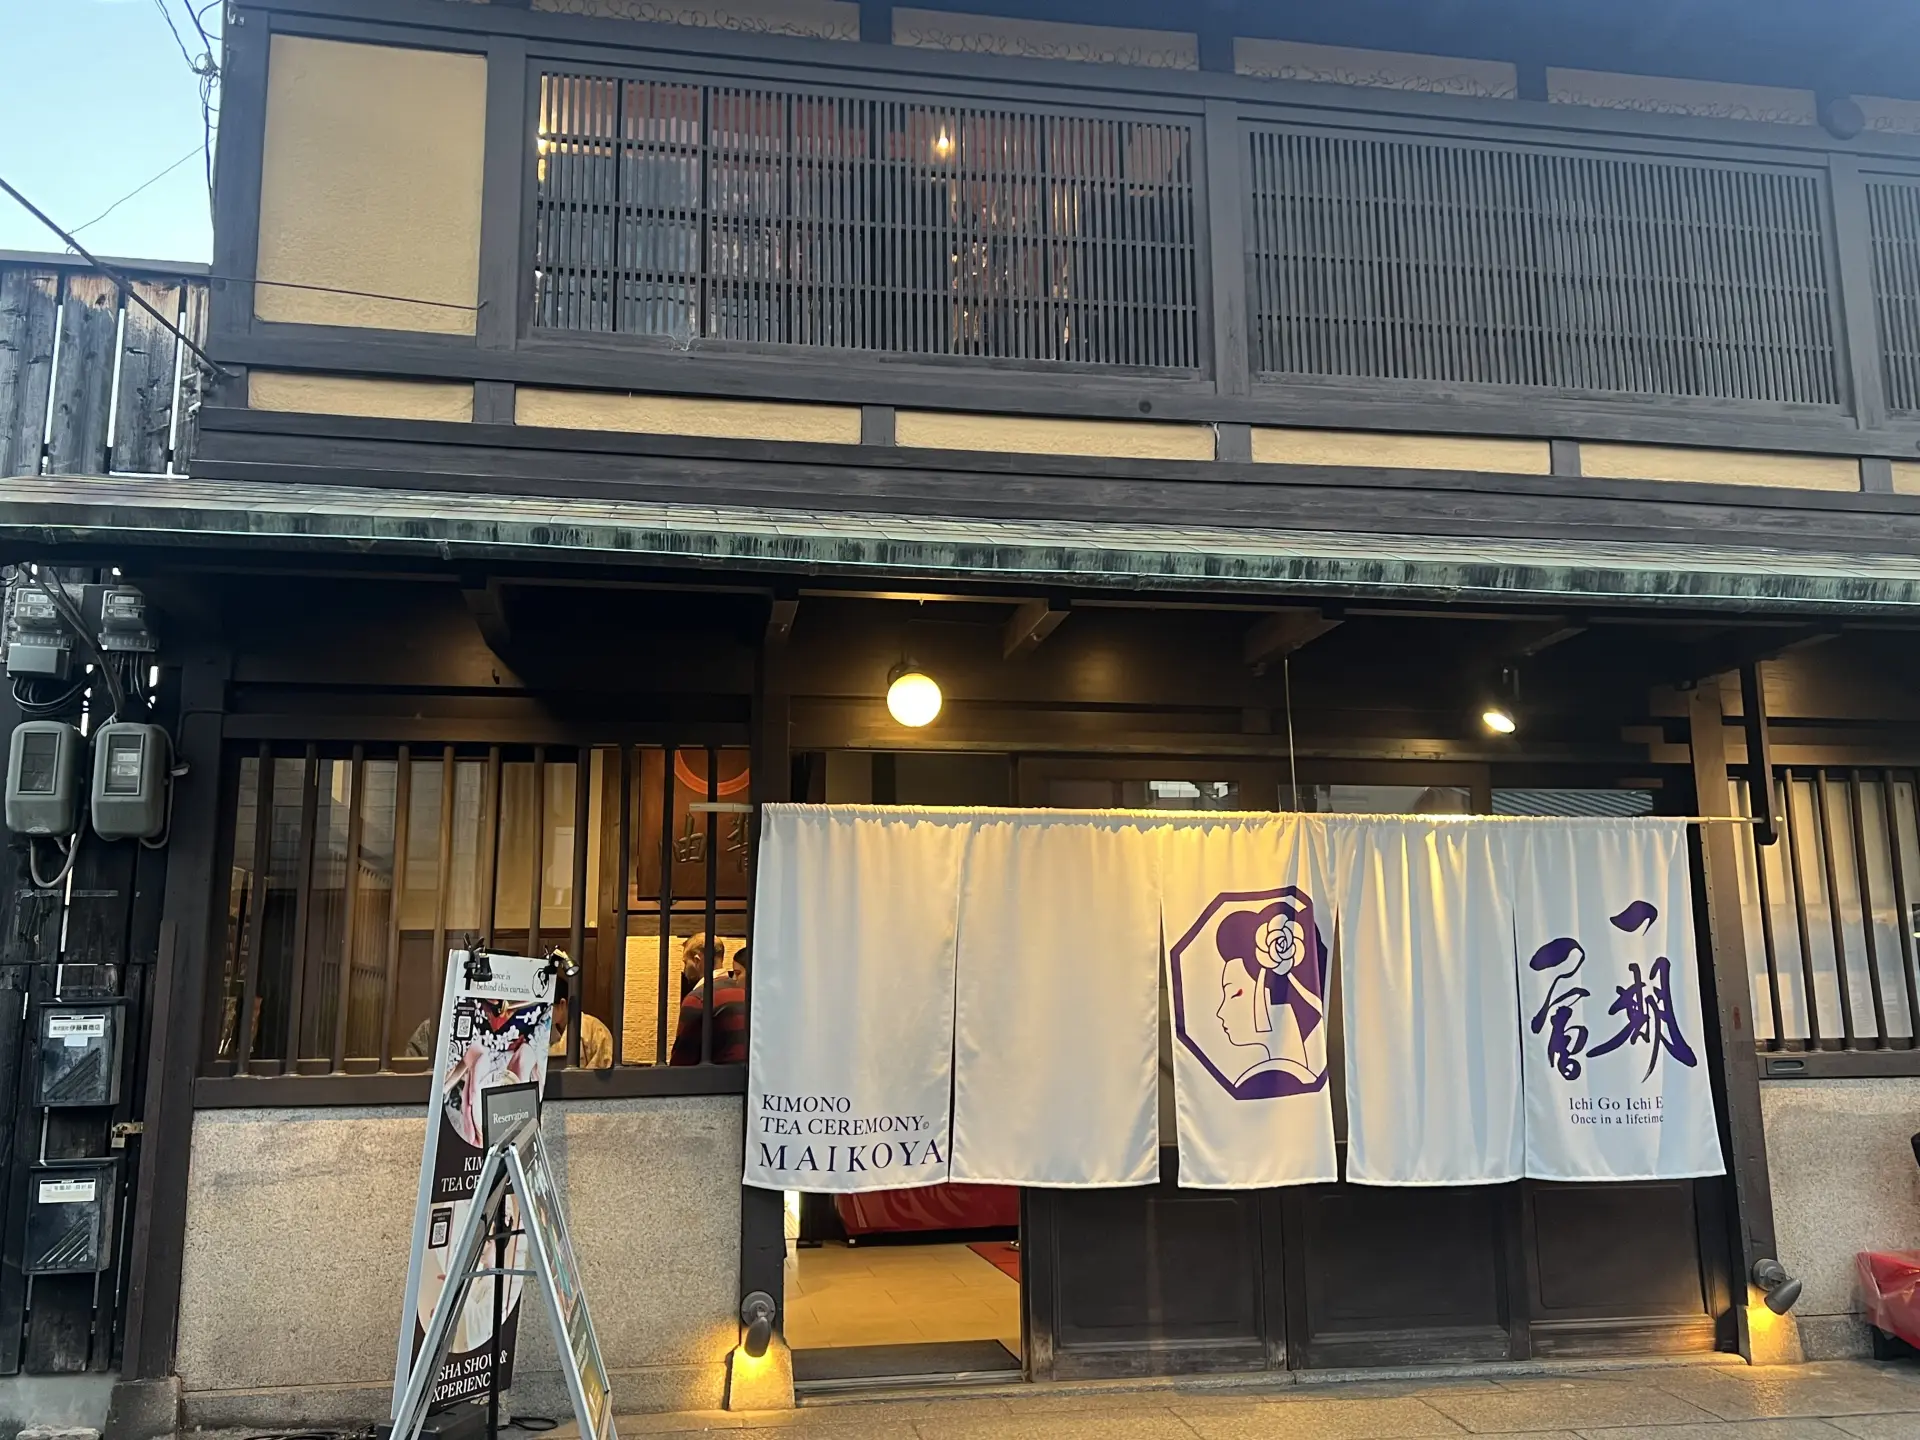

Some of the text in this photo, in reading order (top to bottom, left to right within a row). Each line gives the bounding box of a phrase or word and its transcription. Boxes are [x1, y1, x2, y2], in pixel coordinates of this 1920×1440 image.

[477, 982, 498, 993] behind
[498, 983, 509, 993] this
[762, 1094, 851, 1114] KIMONO
[1569, 1096, 1664, 1110] Ichi Go Ichi E
[493, 1109, 529, 1125] Reservation
[1571, 1113, 1664, 1124] Once in a lifetime
[760, 1116, 802, 1135] TEA
[758, 1138, 945, 1173] MAIKOYA
[441, 1176, 463, 1192] TEA
[499, 1349, 508, 1364] &
[432, 1372, 491, 1403] XPERIENC
